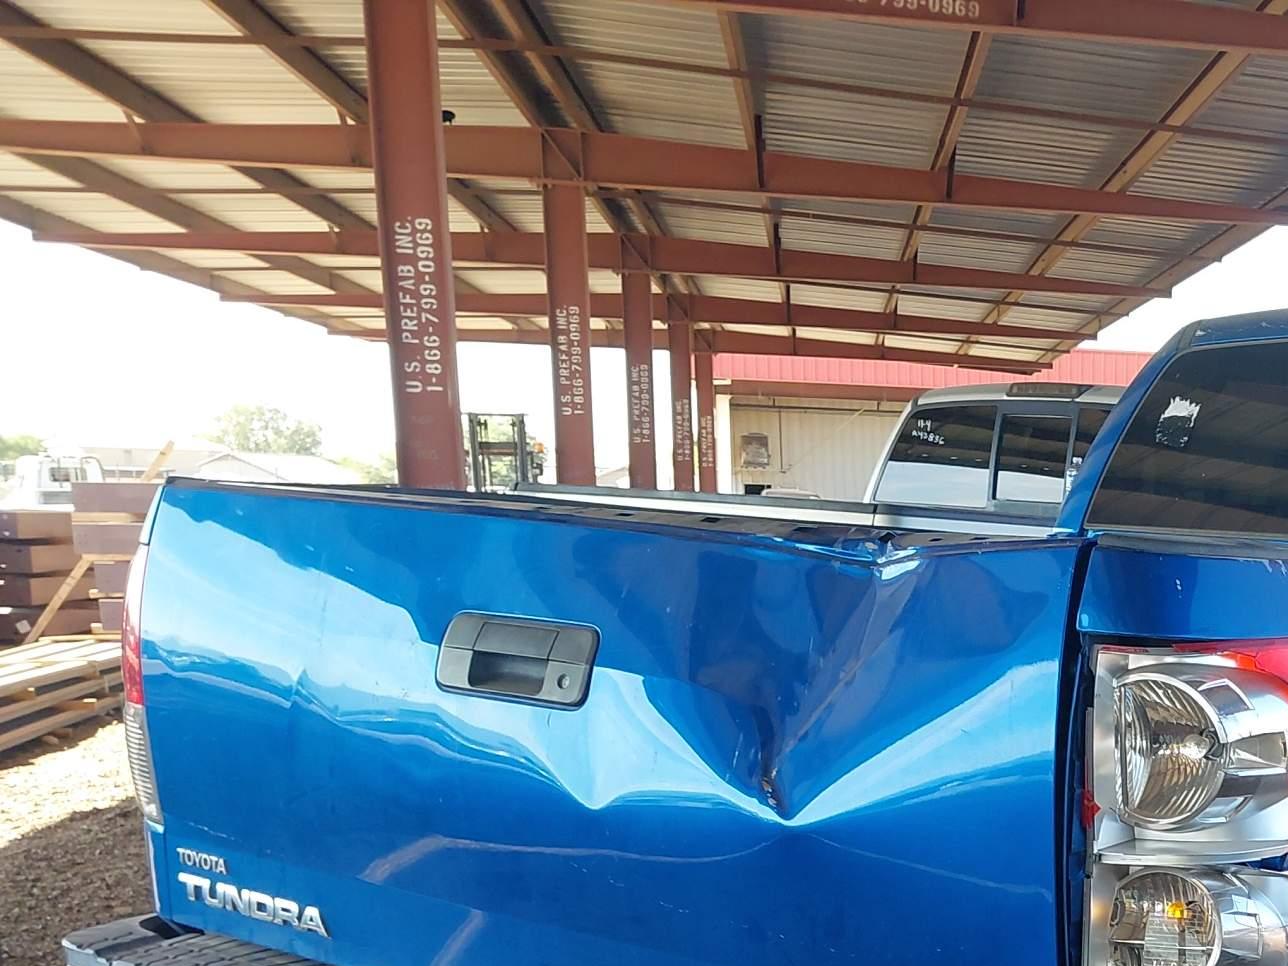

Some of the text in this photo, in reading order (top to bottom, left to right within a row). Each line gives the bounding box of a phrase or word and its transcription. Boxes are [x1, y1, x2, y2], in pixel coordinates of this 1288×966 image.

[394, 216, 424, 393] U.S. PREFAB INC.
[415, 217, 444, 392] 1-866-799-0969
[556, 304, 573, 415] U.S. PREFAB INC.
[568, 306, 584, 415] 1-866-799-0969
[176, 847, 227, 875] TOYOTA
[177, 872, 330, 939] TUNDRA
